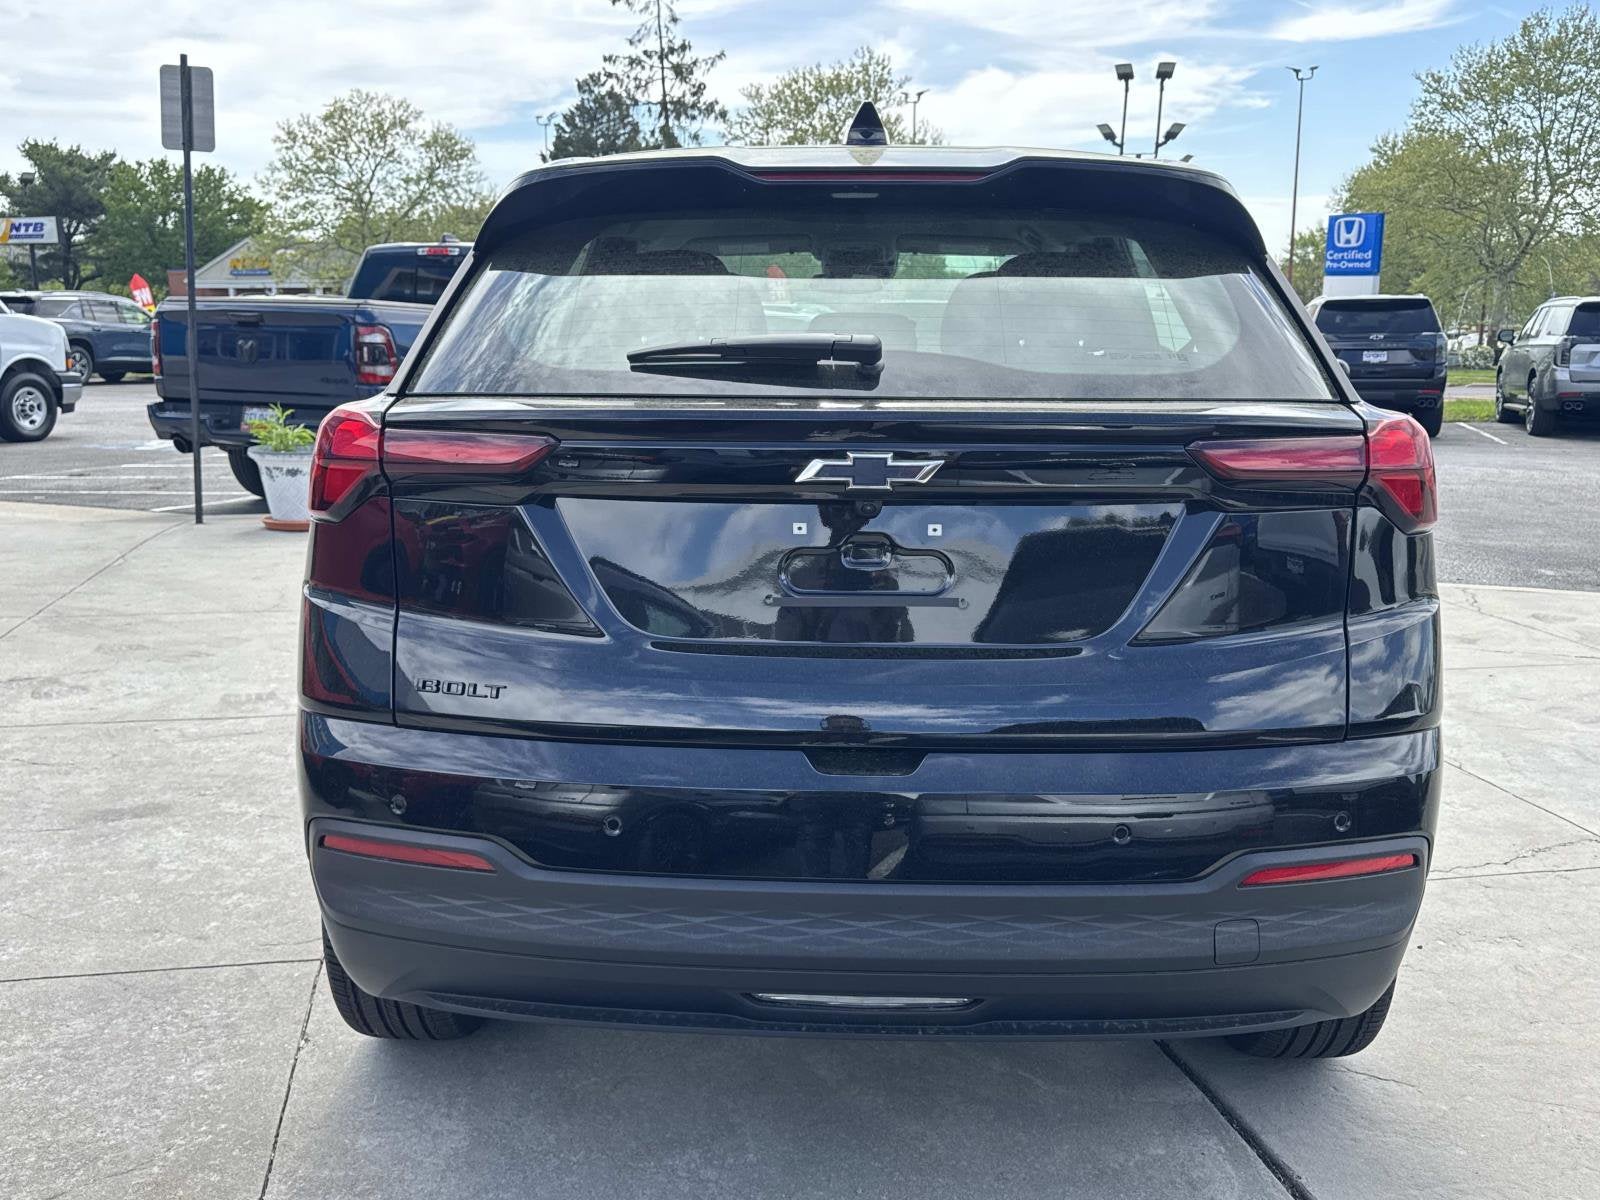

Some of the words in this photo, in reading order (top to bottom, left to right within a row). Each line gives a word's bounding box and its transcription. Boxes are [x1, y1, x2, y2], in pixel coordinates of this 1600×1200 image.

[10, 222, 44, 233] NTB
[1326, 250, 1372, 260] Certified
[1325, 260, 1371, 269] Pre-Owned
[416, 678, 507, 700] BOLT
